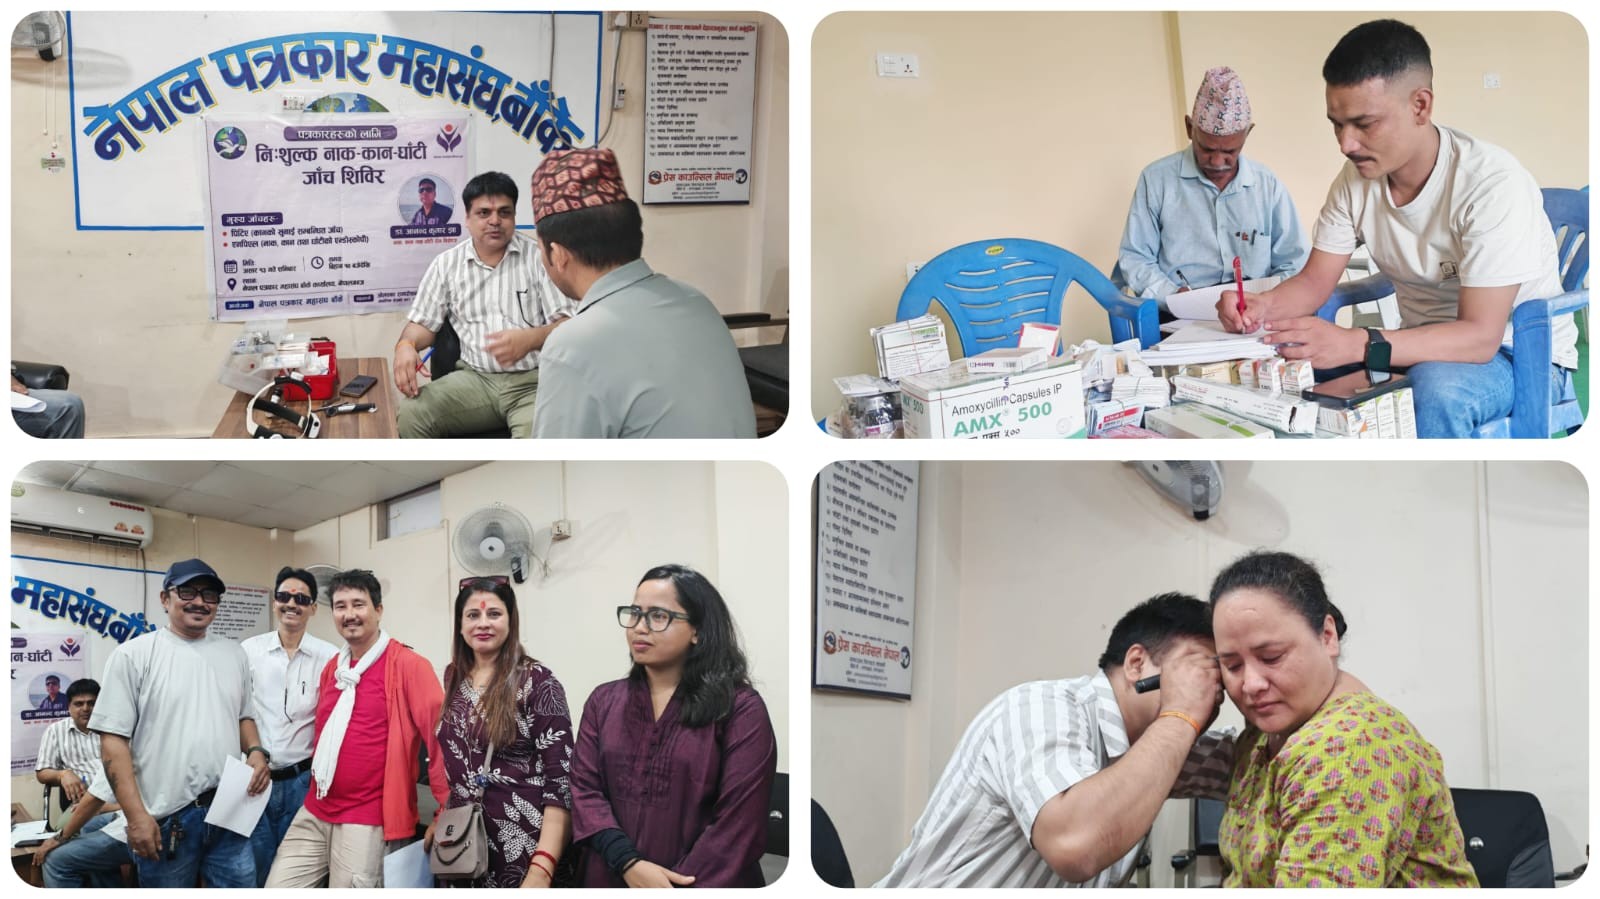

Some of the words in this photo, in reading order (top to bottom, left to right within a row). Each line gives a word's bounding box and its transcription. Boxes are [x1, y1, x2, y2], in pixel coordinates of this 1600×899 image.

[83, 57, 216, 160] नेपाल
[208, 32, 378, 92] पत्रकार
[360, 127, 382, 139] लागि
[302, 166, 335, 185] जाँच
[341, 165, 386, 185] शिविर
[714, 171, 735, 181] नेपाल
[258, 300, 277, 308] नेपाल
[280, 298, 303, 306] पत्रकार
[951, 396, 1007, 417] Amoxycillin
[1009, 386, 1051, 404] Capsules
[1053, 383, 1062, 394] IP
[953, 412, 1003, 437] AMX
[1018, 401, 1052, 422] 500
